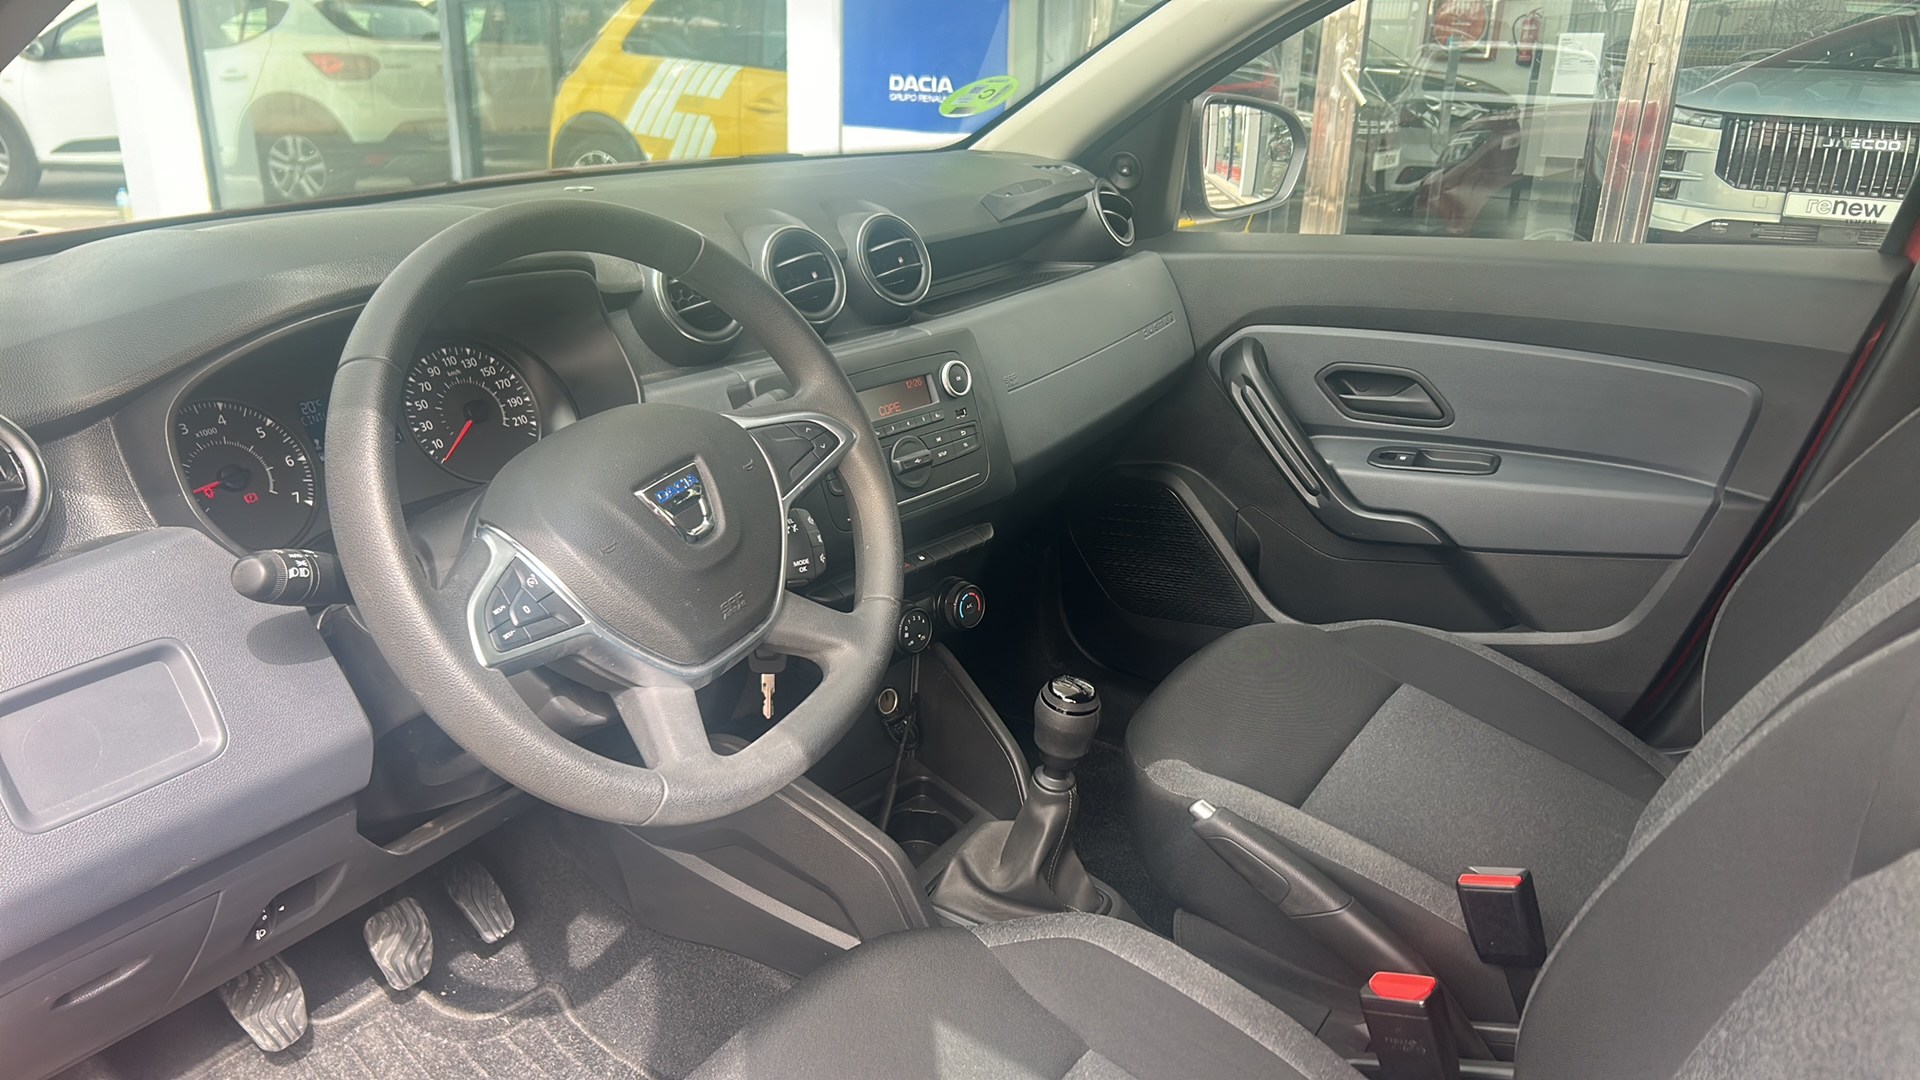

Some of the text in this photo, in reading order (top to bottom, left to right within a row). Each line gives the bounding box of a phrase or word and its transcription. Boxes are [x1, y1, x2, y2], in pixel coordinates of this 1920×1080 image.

[889, 74, 953, 93] DACIA
[889, 93, 917, 101] GRUPO
[1806, 199, 1886, 218] renew
[442, 356, 458, 367] 110
[461, 358, 477, 369] 130
[427, 366, 441, 377] 90
[480, 366, 496, 377] 150
[418, 381, 432, 392] 70
[495, 378, 511, 390] 170
[414, 400, 429, 411] 50
[507, 396, 523, 408] 190
[878, 401, 901, 417] COPE
[218, 414, 227, 425] 4
[512, 415, 528, 427] 210
[178, 423, 189, 435] 3
[419, 421, 433, 432] 30
[256, 427, 266, 439] 5
[432, 438, 444, 449] 10
[285, 455, 295, 467] 6
[655, 473, 699, 504] DACIA
[291, 491, 300, 503] 7
[792, 558, 810, 567] MODE
[798, 565, 808, 573] OK
